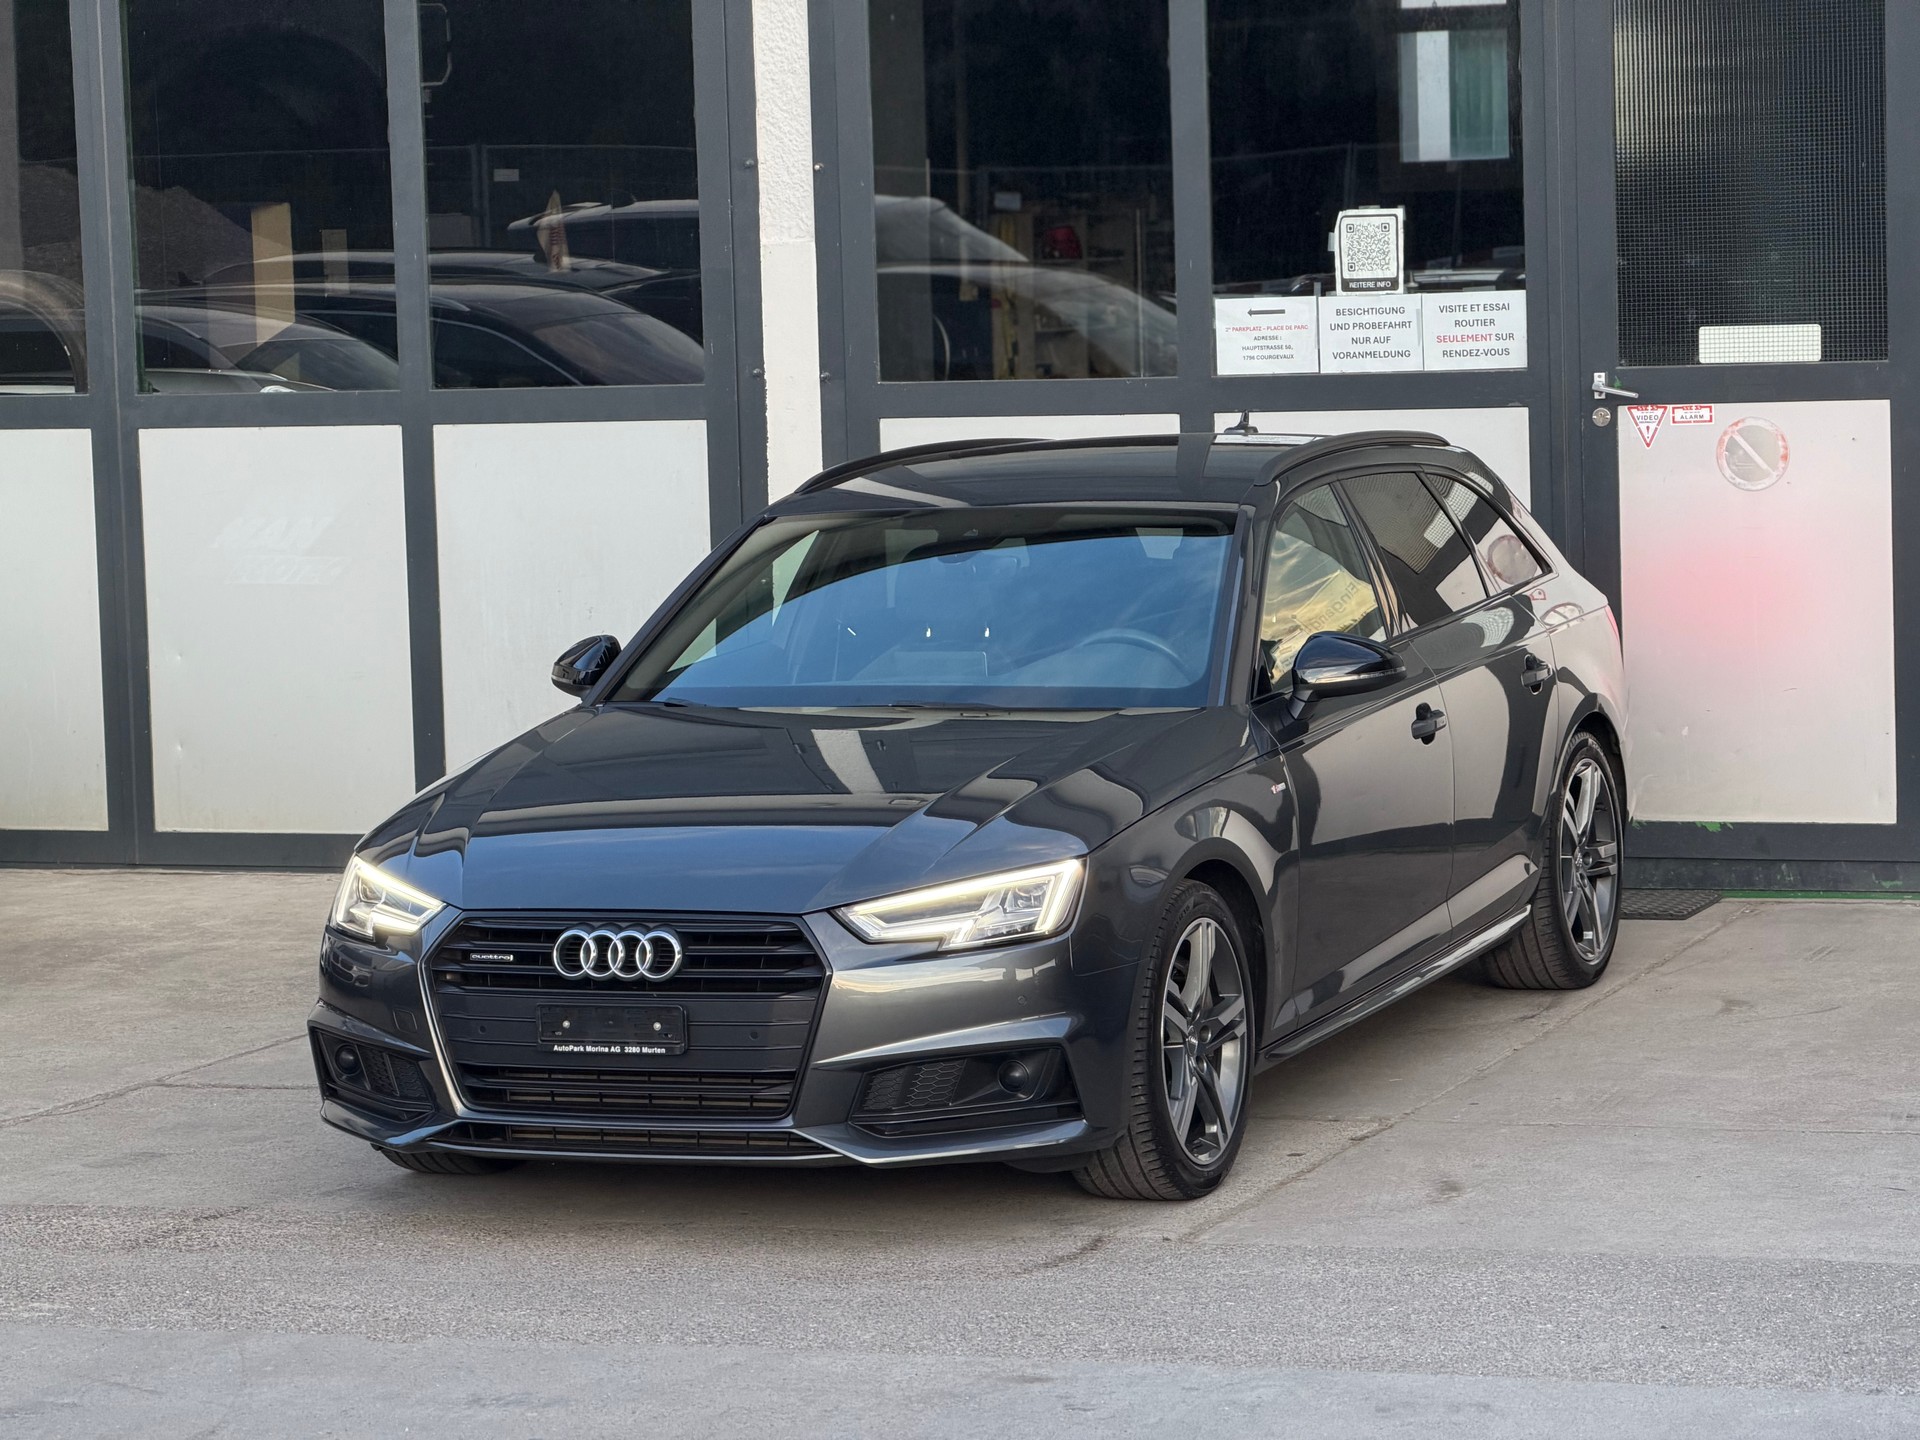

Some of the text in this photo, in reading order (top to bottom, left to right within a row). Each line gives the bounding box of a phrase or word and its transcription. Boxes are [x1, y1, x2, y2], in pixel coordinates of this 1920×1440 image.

[1336, 306, 1406, 316] BESICHTIGUNG
[1438, 303, 1510, 313] VISITE ET ESSAI
[1330, 321, 1412, 331] UND PROBEFAHRT
[1454, 318, 1496, 328] ROUTIER
[1351, 336, 1391, 345] NUR AUF
[1436, 333, 1515, 343] SEULEMENT SUR
[1332, 350, 1411, 360] VORANMELDUNG
[1442, 348, 1510, 358] RENDEZ-VOUS
[553, 1044, 584, 1052] AutoPark
